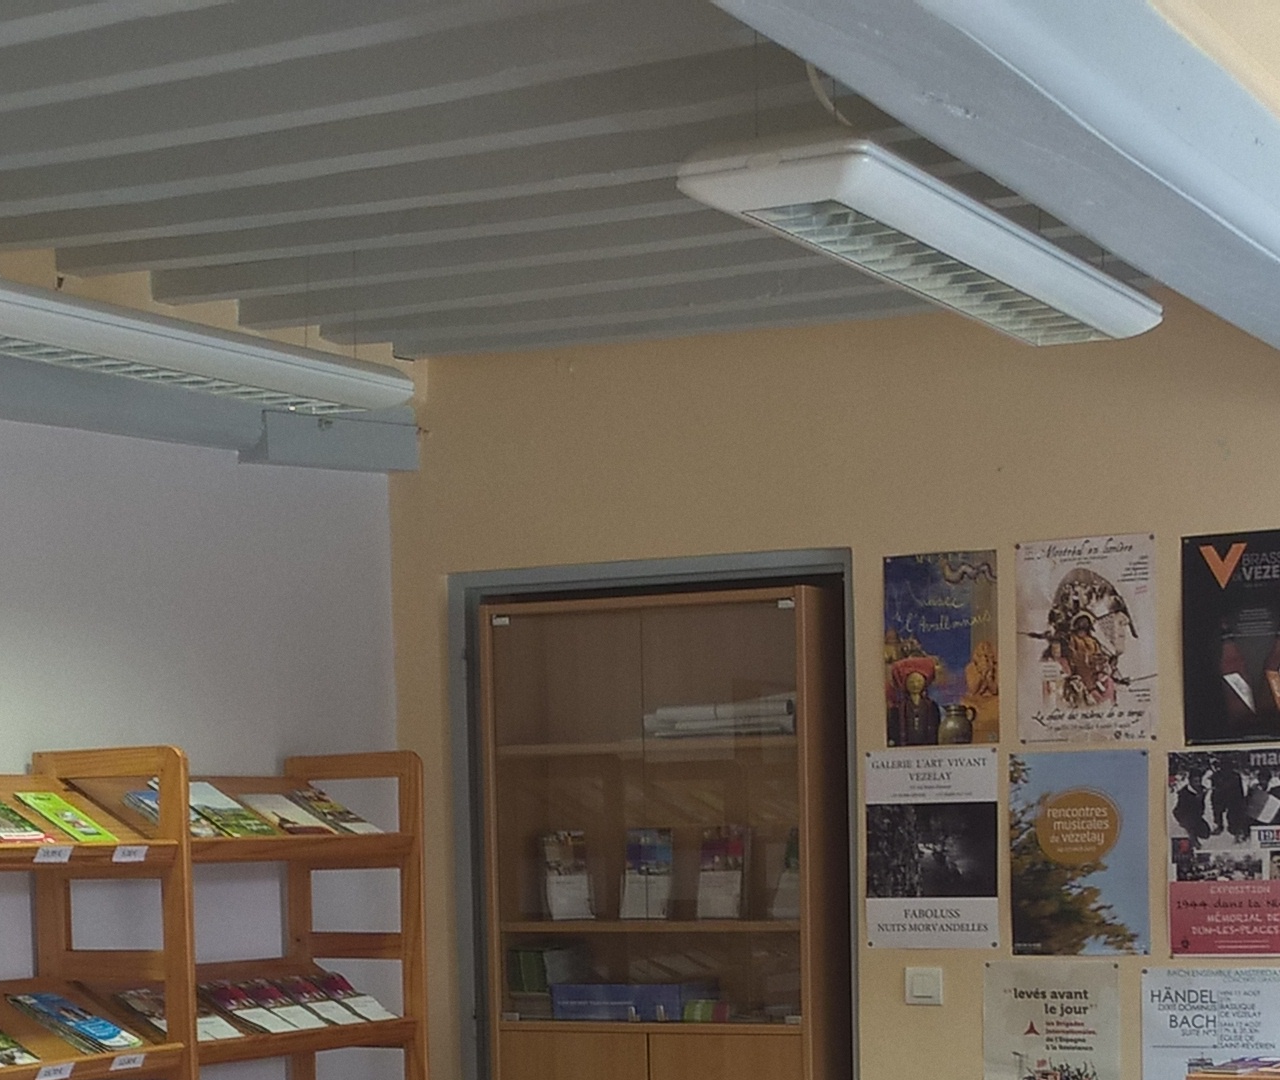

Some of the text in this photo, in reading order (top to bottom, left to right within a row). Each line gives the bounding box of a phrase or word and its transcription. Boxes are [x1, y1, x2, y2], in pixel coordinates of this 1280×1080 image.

[872, 757, 987, 769] GALERIE L'ART VIVANT
[908, 771, 952, 782] VEZELAY
[1047, 805, 1108, 818] rencontres
[1053, 817, 1110, 830] musicales
[878, 922, 989, 933] NUITS MORVANDELLES
[1050, 989, 1089, 1000] avant
[1150, 986, 1217, 1004] HÄNDEL
[1044, 1003, 1056, 1014] le
[1169, 1014, 1217, 1029] BACH
